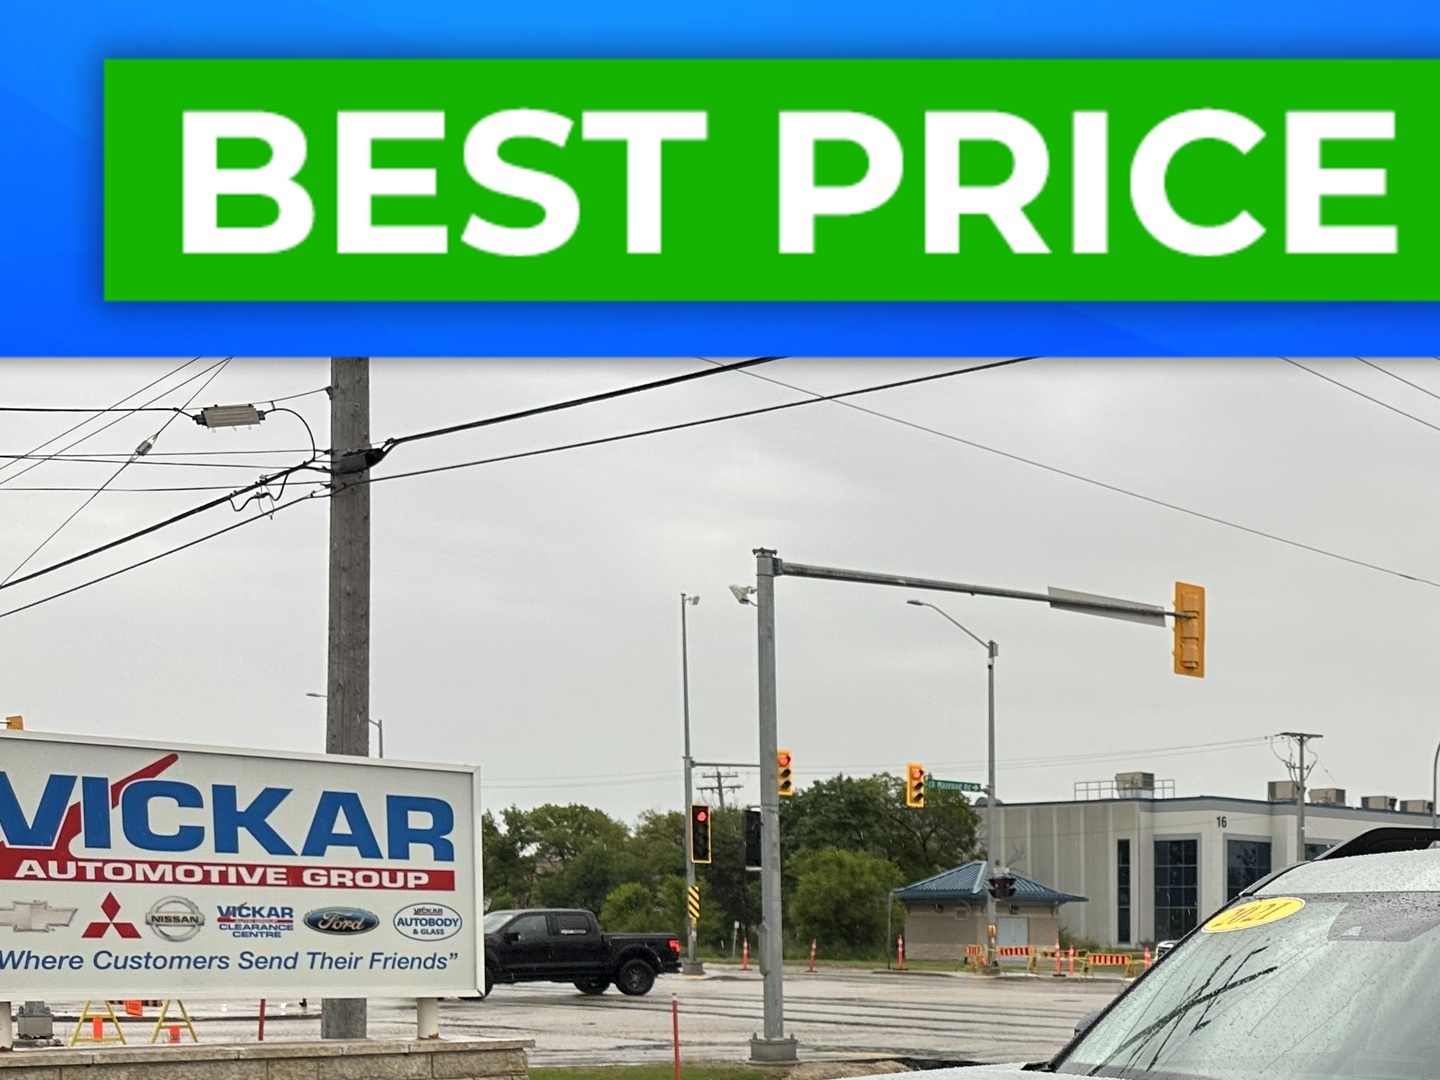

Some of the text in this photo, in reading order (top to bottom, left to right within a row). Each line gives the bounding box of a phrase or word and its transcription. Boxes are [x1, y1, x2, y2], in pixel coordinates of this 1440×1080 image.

[0, 771, 455, 862] VICKAR
[1216, 815, 1227, 828] 16
[15, 859, 429, 888] AUTOMOTIVE GROUP
[151, 914, 199, 924] NISSAN
[217, 903, 294, 918] VICKAR
[1211, 901, 1293, 928] 2021
[318, 911, 364, 931] Ford
[397, 917, 460, 927] AUTOBODY
[93, 950, 230, 970] Customers
[238, 951, 298, 970] Send
[306, 952, 363, 970] Their
